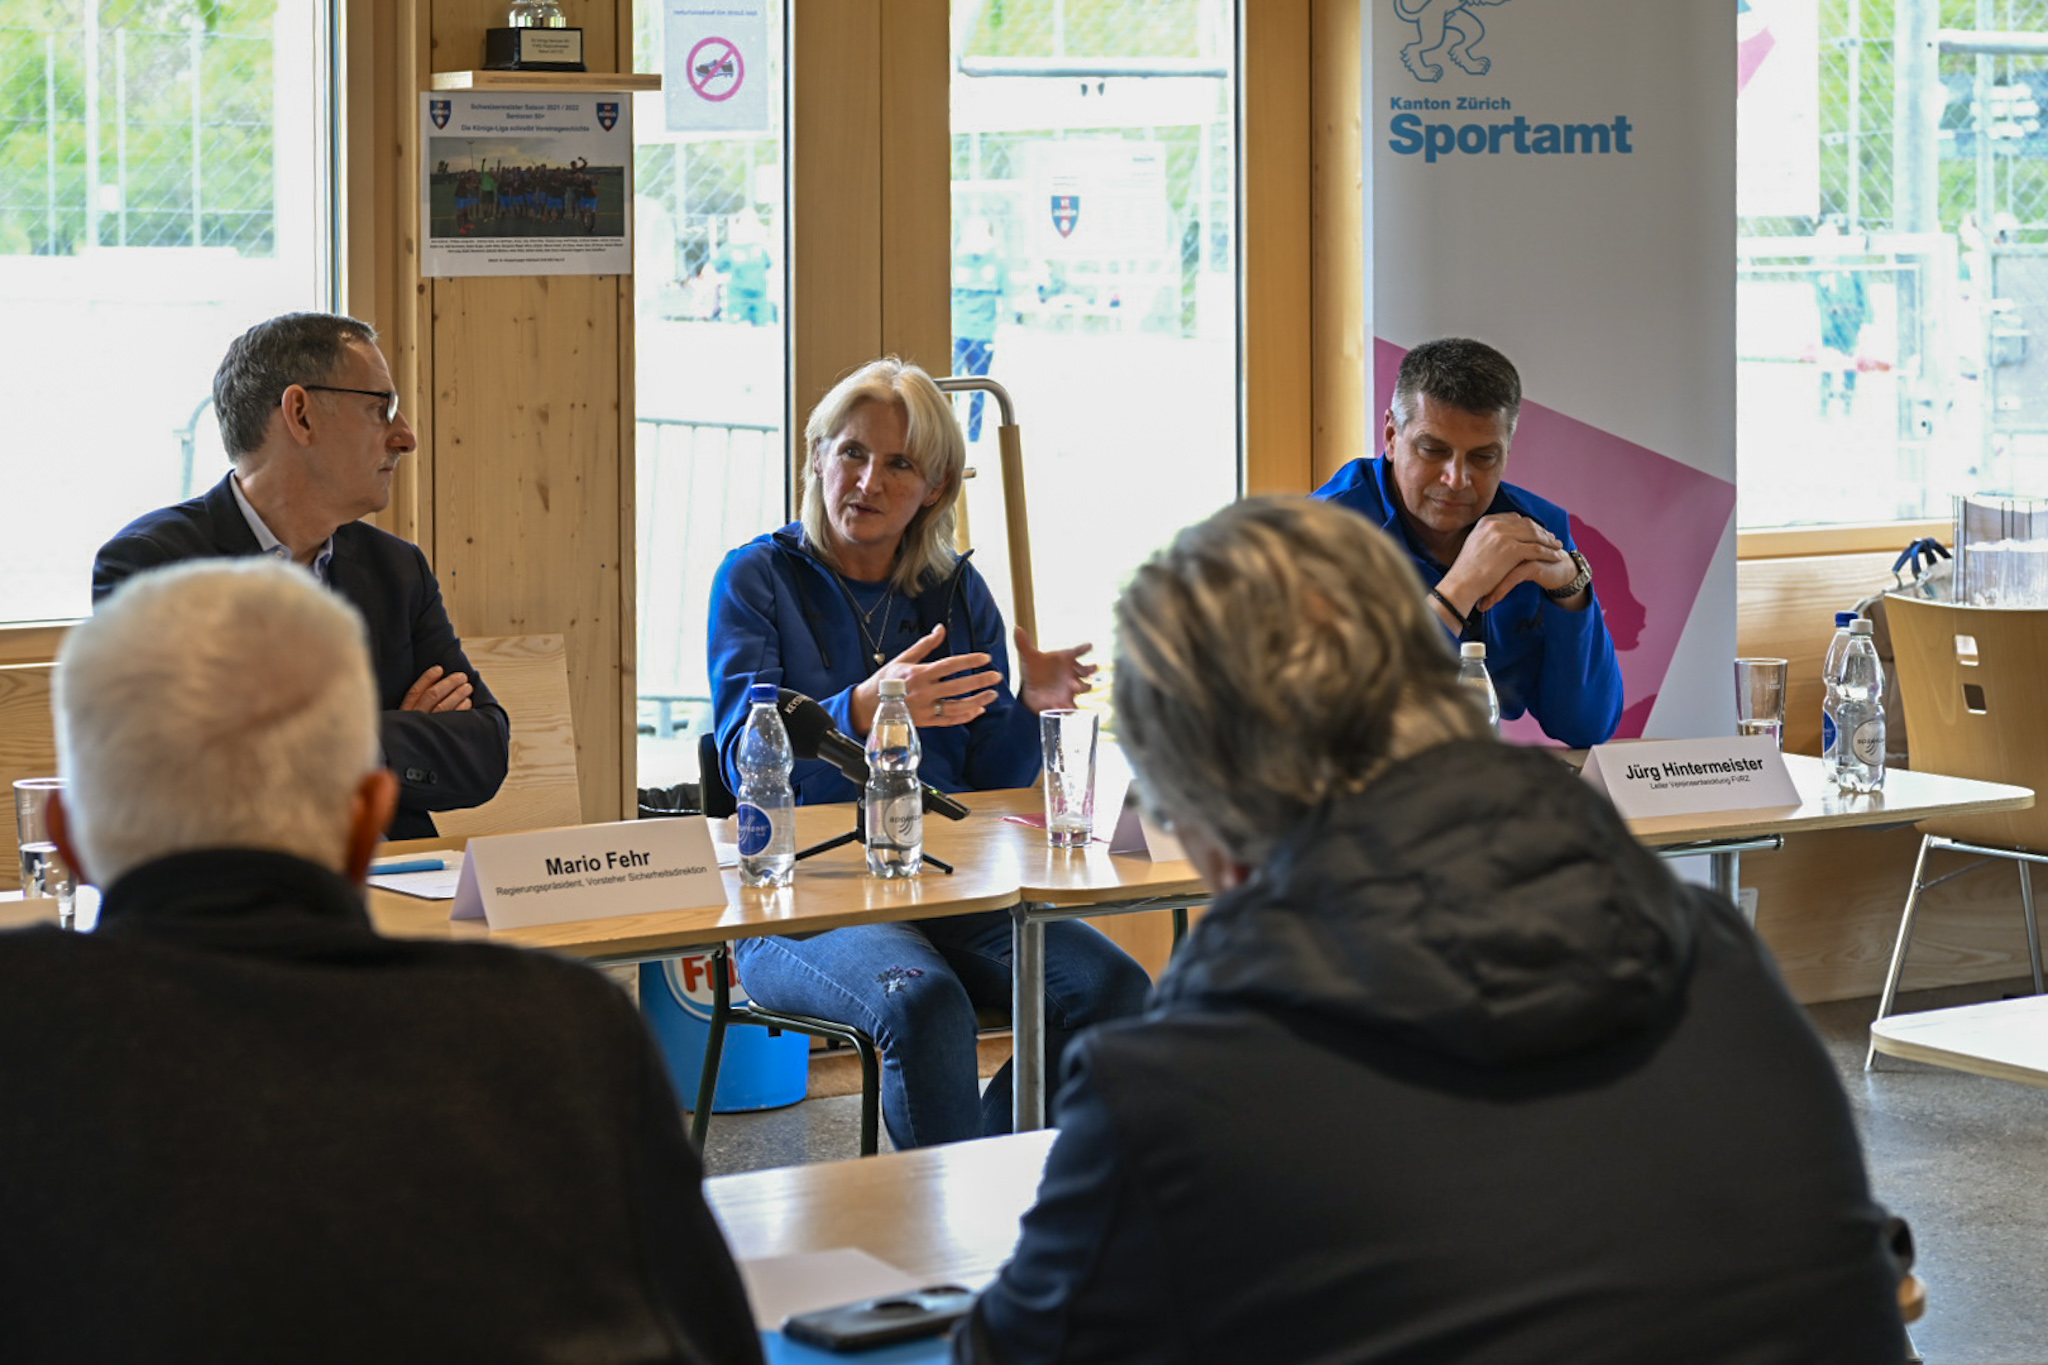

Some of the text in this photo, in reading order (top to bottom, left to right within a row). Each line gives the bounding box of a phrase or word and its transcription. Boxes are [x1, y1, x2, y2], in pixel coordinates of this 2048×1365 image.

[1390, 96, 1512, 110] Kanton Zürich
[1388, 113, 1633, 163] Sportamt
[1626, 757, 1763, 781] Jürg Hintermeister
[545, 850, 651, 876] Mario Fehr
[495, 865, 708, 897] Regierungspräsident, Vorsteher Sicherheitsdirektion
